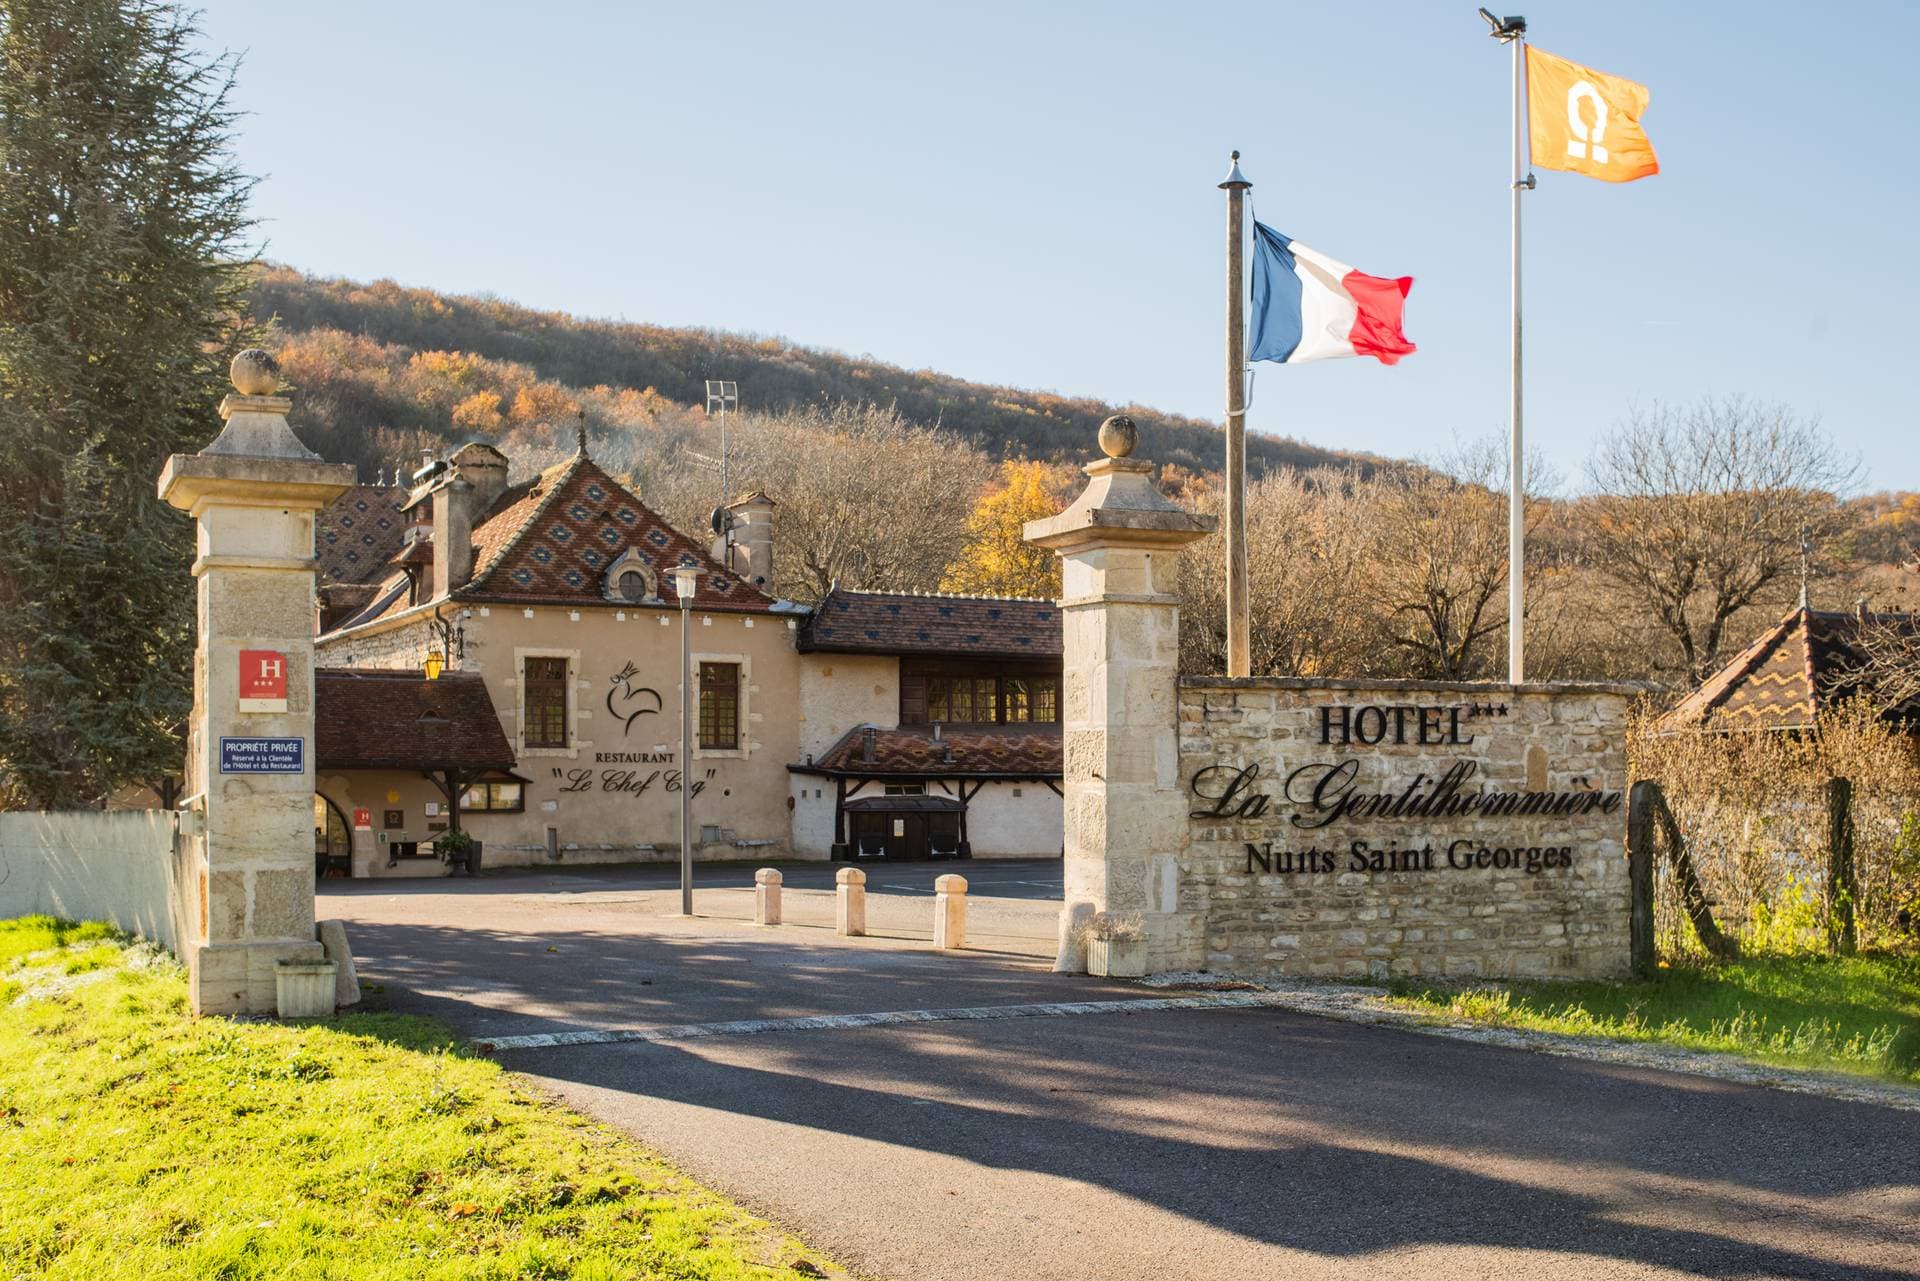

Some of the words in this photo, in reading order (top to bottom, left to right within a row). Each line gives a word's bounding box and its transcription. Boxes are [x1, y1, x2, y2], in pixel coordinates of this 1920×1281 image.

[261, 660, 281, 678] H
[1318, 705, 1475, 745] HOTEL
[226, 742, 268, 753] PROPRIÉTÉ
[271, 742, 298, 753] PRIVÉE
[232, 754, 255, 762] Réservé
[595, 752, 675, 763] RESTAURANT
[601, 769, 661, 798] Chef
[663, 768, 716, 799] Cq"
[1189, 762, 1272, 821] La
[1284, 758, 1622, 830] Gentilhommière
[1244, 842, 1335, 875] Nuits
[1350, 841, 1433, 873] Saint
[1447, 839, 1573, 874] Georges
